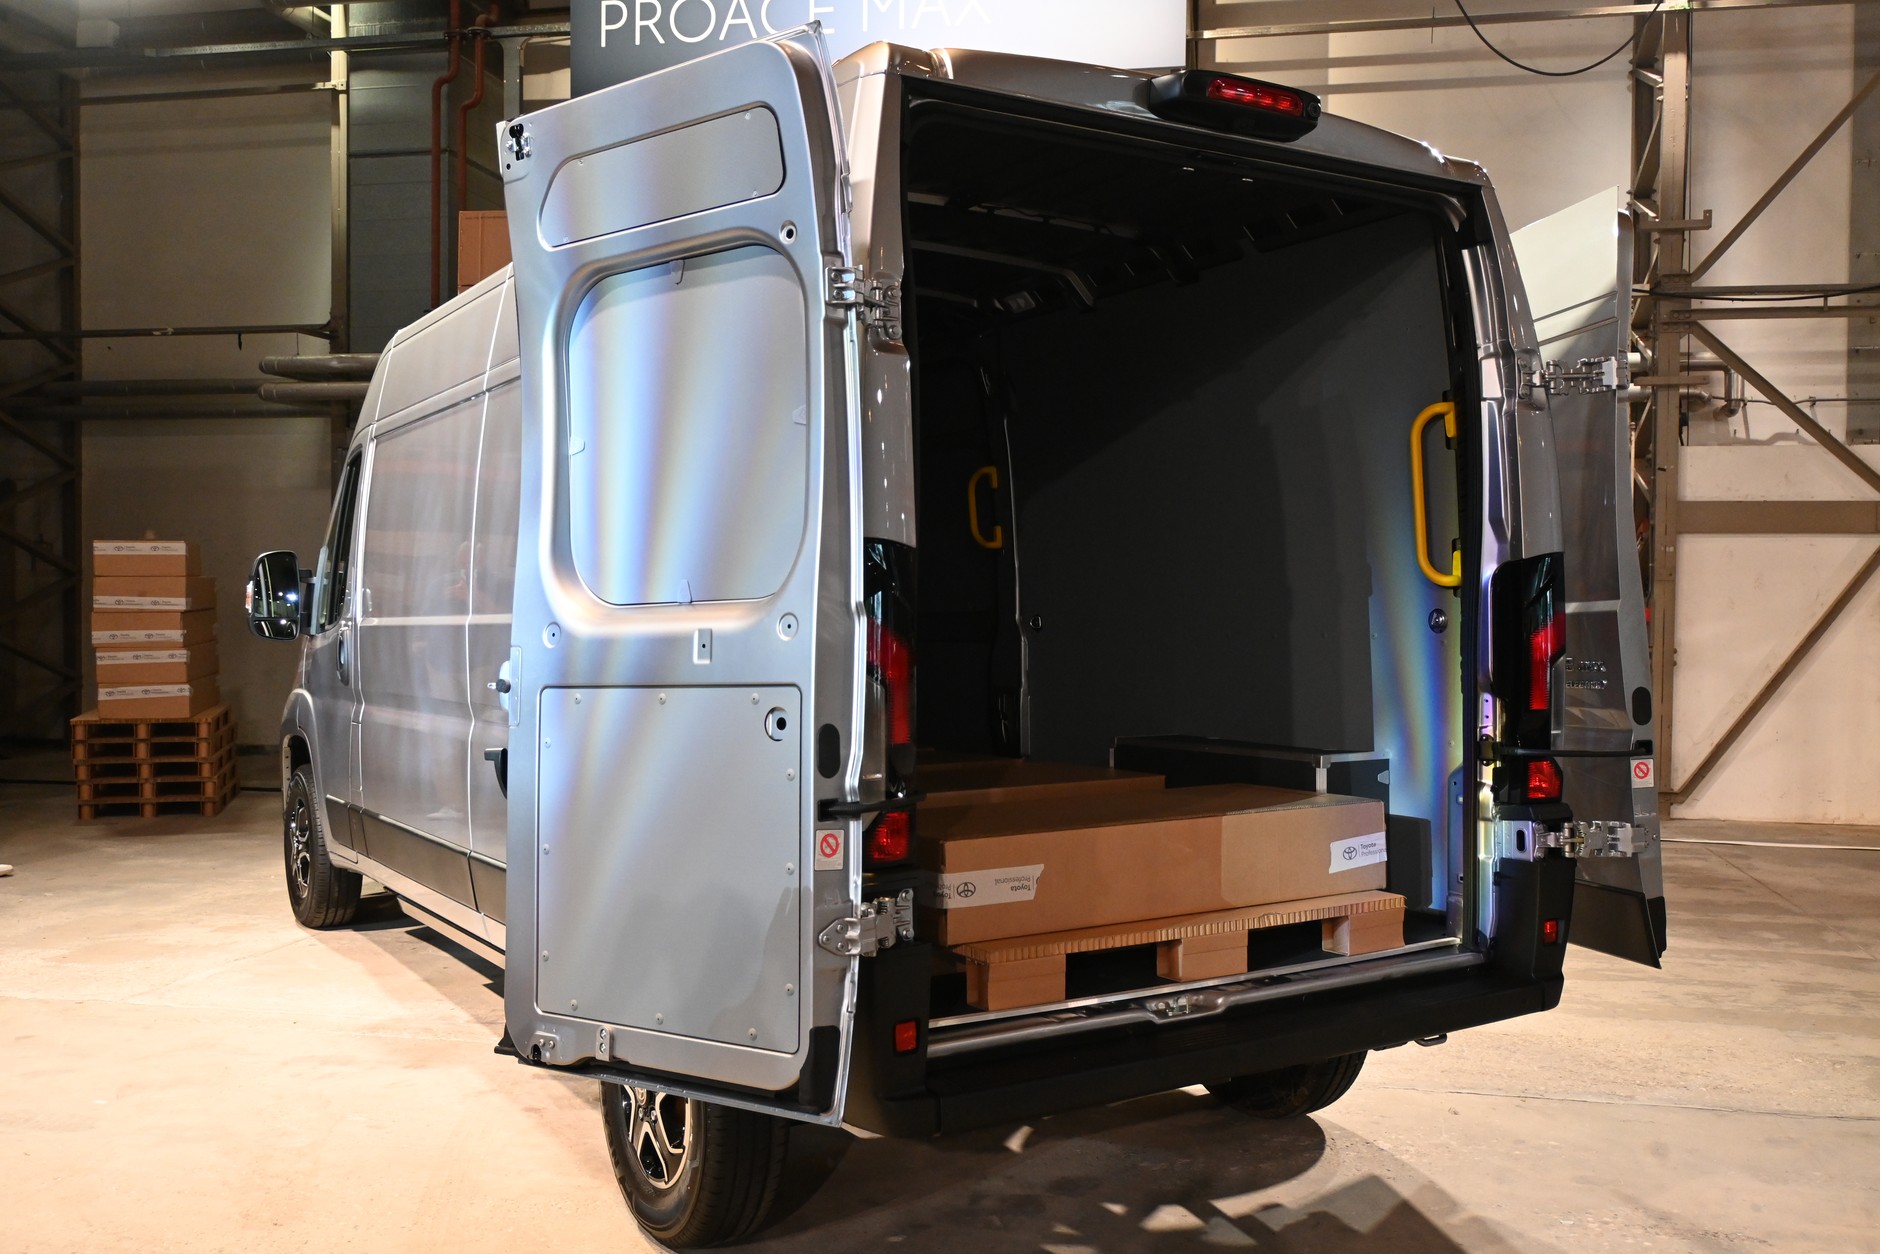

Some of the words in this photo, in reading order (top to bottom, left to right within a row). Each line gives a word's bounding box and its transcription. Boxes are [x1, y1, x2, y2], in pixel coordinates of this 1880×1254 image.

[1360, 842, 1377, 850] Toyota
[994, 876, 1031, 886] Professional
[1010, 884, 1031, 892] Toyota
